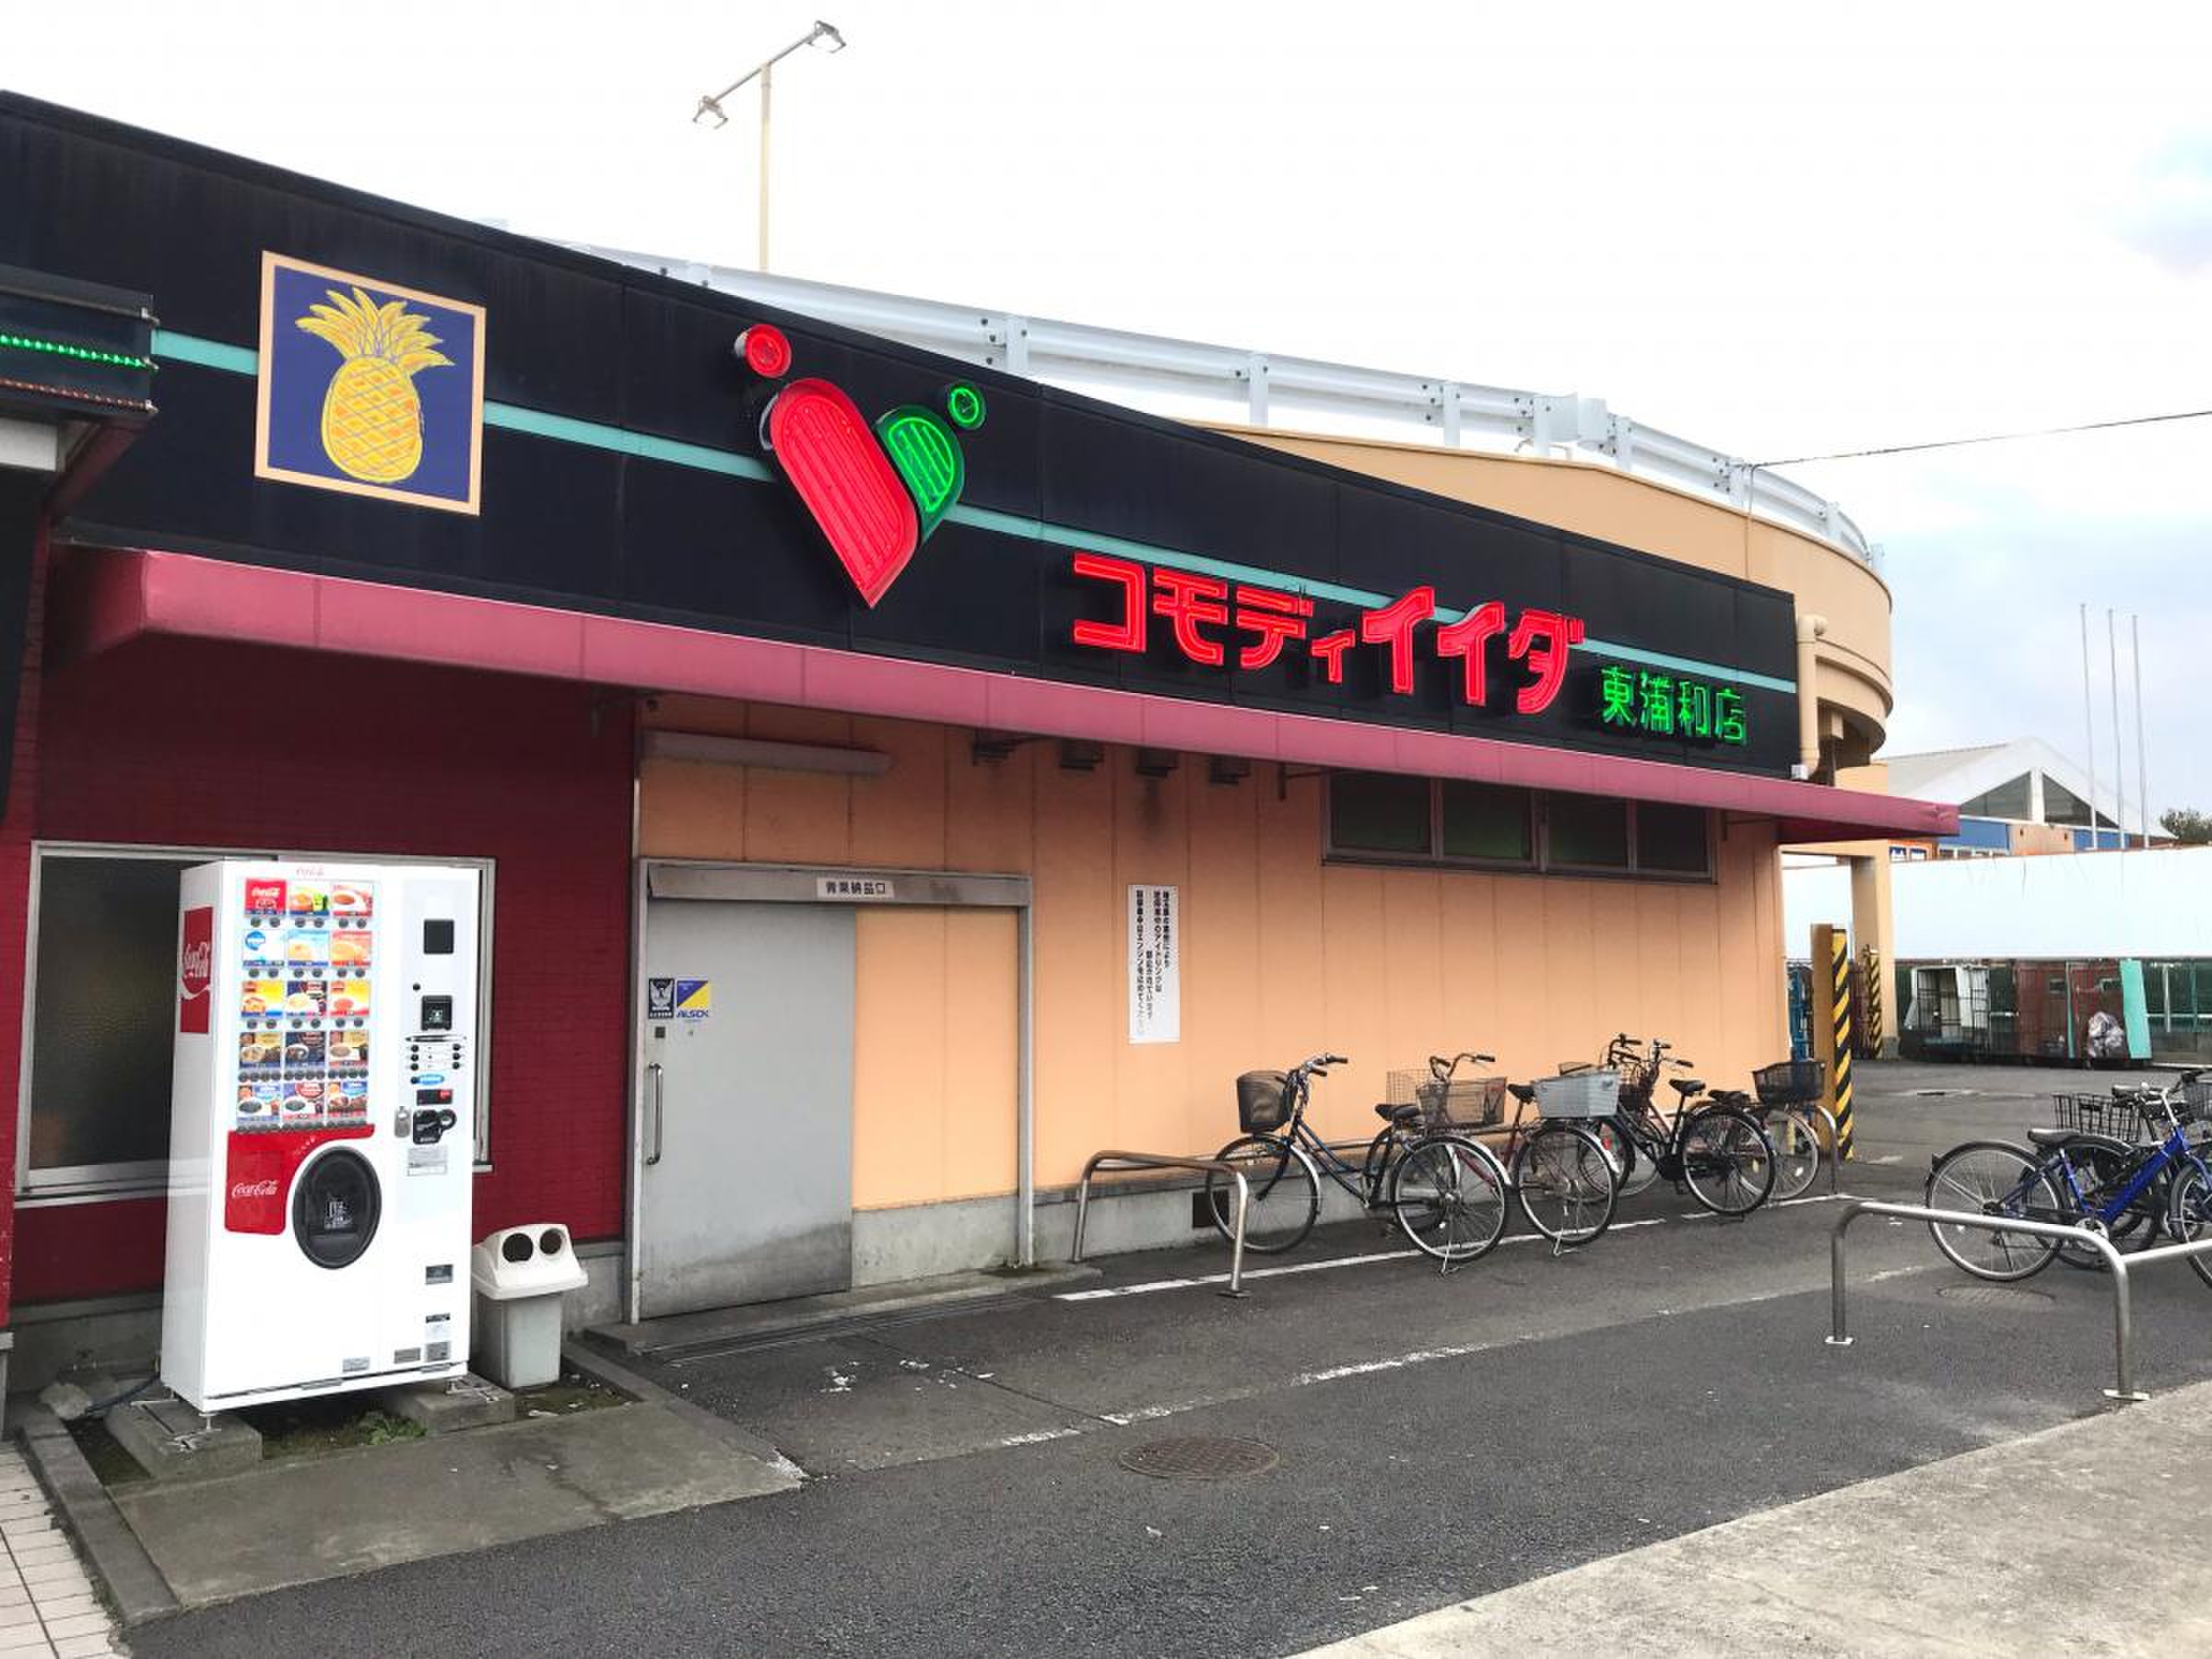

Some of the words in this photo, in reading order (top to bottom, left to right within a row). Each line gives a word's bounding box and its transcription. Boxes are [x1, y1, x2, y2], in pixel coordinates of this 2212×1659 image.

[1073, 552, 1585, 714] コモディイイダ
[1601, 665, 1747, 745] 東浦和店
[231, 1179, 280, 1198] Coca-Cola
